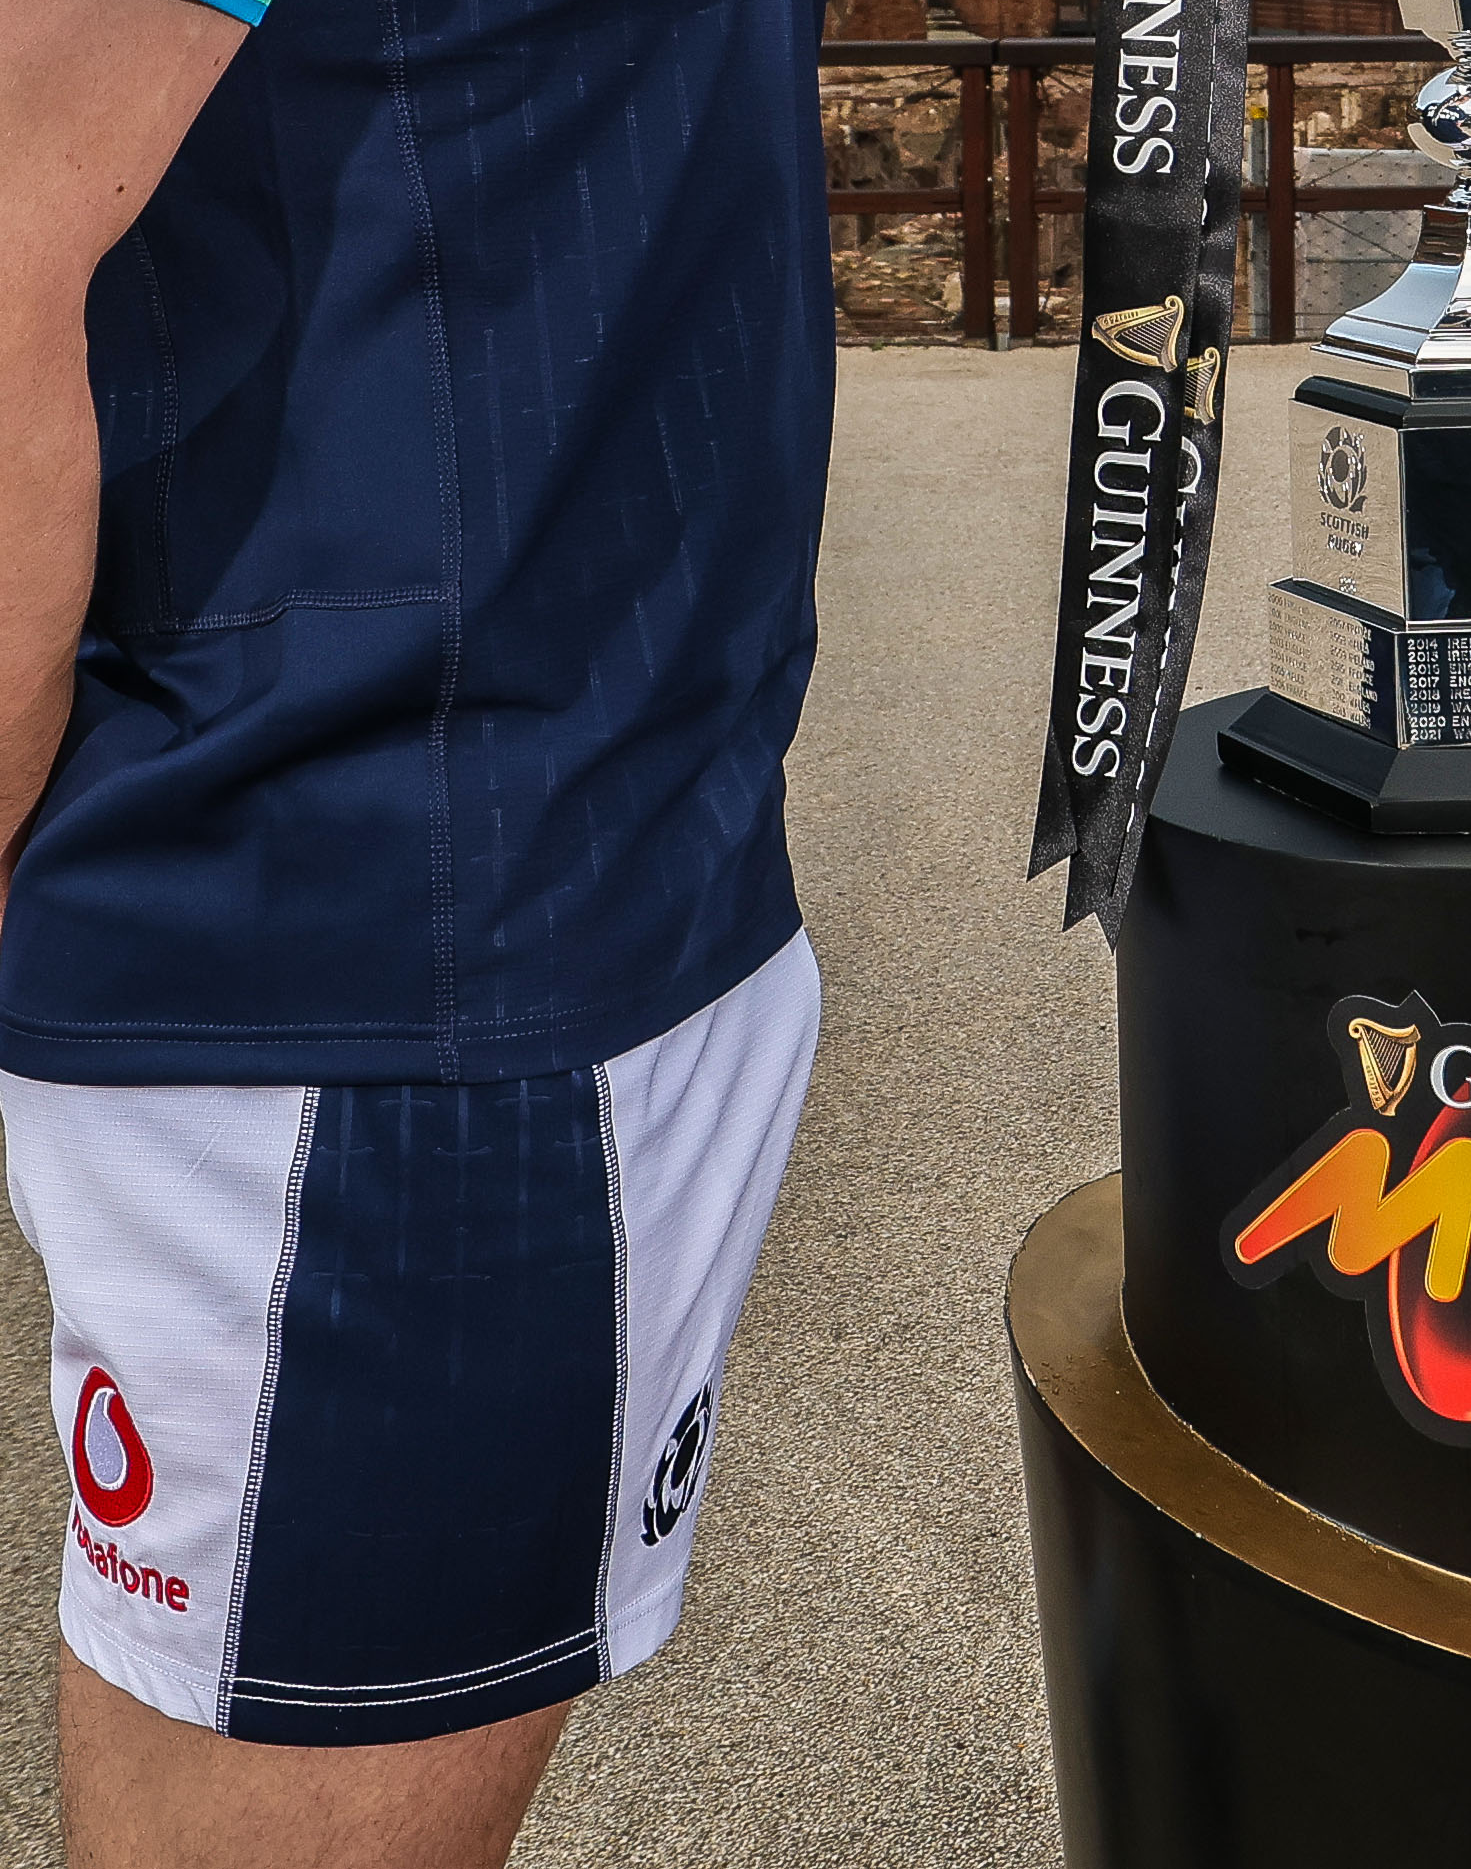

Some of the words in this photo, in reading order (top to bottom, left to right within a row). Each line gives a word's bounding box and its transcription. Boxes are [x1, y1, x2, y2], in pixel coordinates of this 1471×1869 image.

[1320, 512, 1369, 540] SCOTTISH
[1327, 534, 1364, 558] RUGBY
[1071, 379, 1167, 780] GUINNESS
[1407, 638, 1438, 650] 2014
[1407, 651, 1439, 662] 2015
[1409, 677, 1440, 688] 2017
[1409, 689, 1440, 701] 2018
[1410, 702, 1441, 713] 2019
[1410, 716, 1446, 727] 2020
[1410, 728, 1442, 740] 2021
